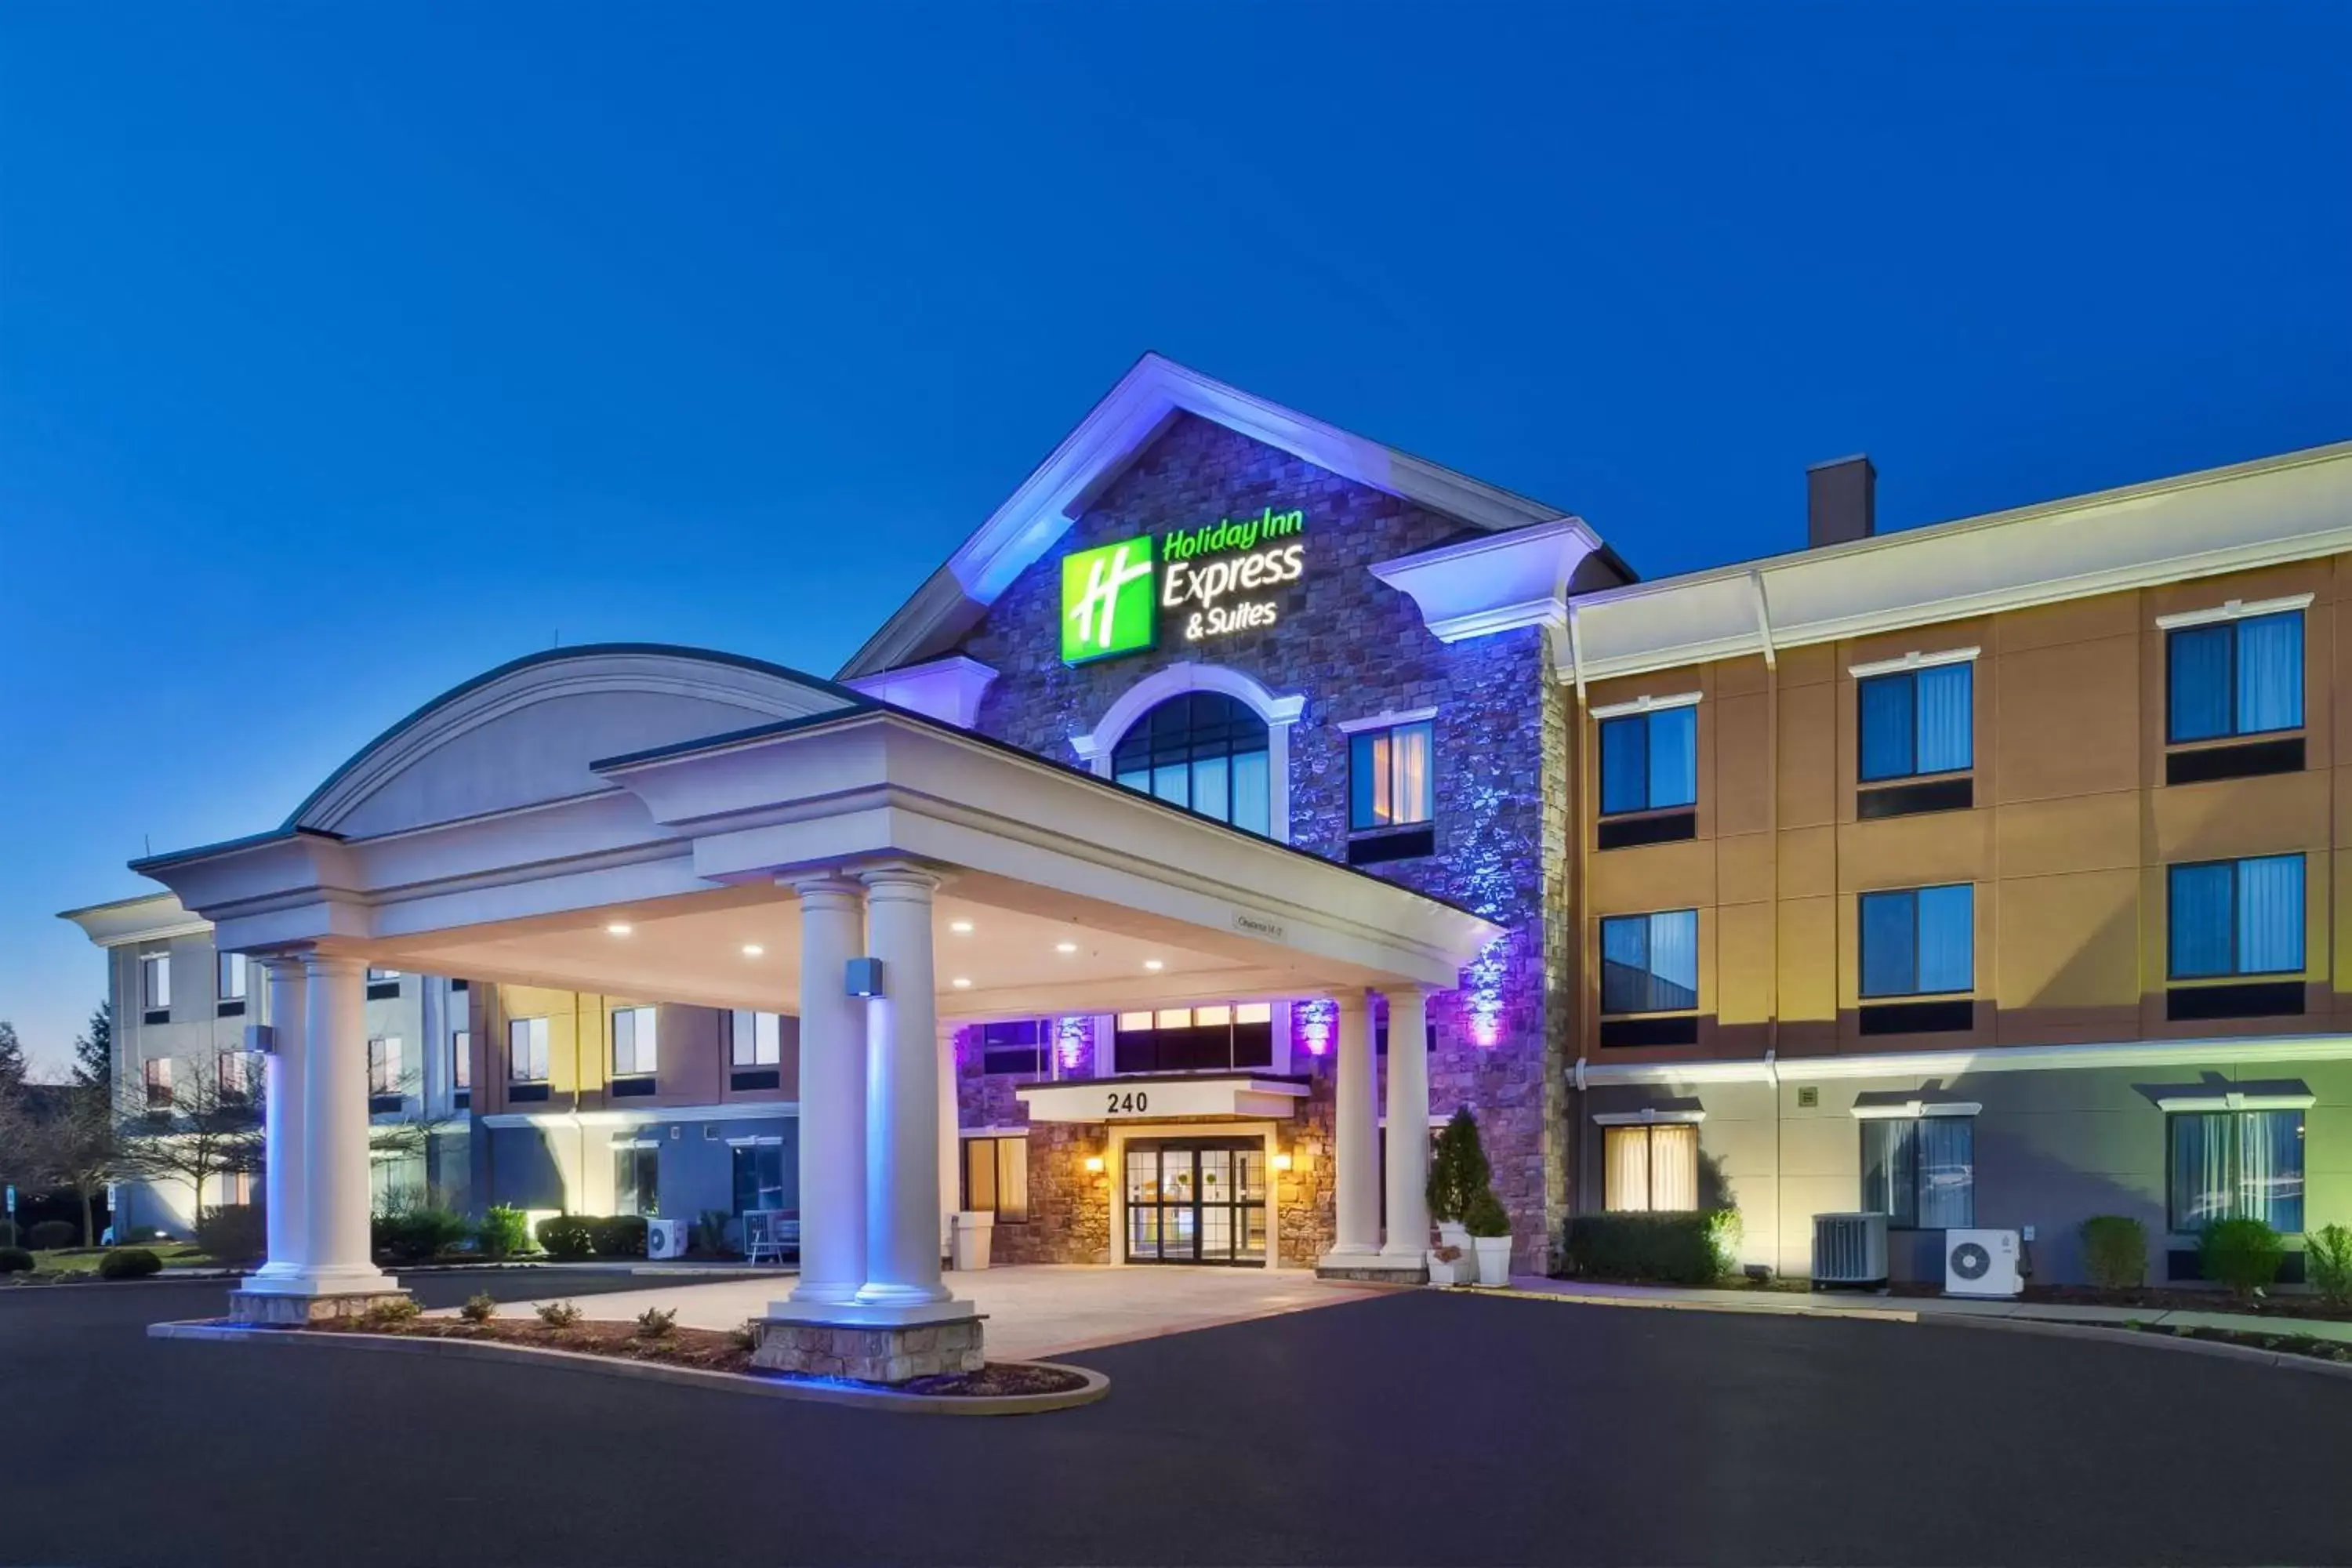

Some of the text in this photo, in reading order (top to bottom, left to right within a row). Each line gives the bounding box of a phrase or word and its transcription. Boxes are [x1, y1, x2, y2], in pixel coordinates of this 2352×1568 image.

[1163, 506, 1304, 561] Holiday Inn
[1163, 544, 1305, 610] Express
[1185, 601, 1277, 641] & Suites
[1107, 1091, 1148, 1113] 240
